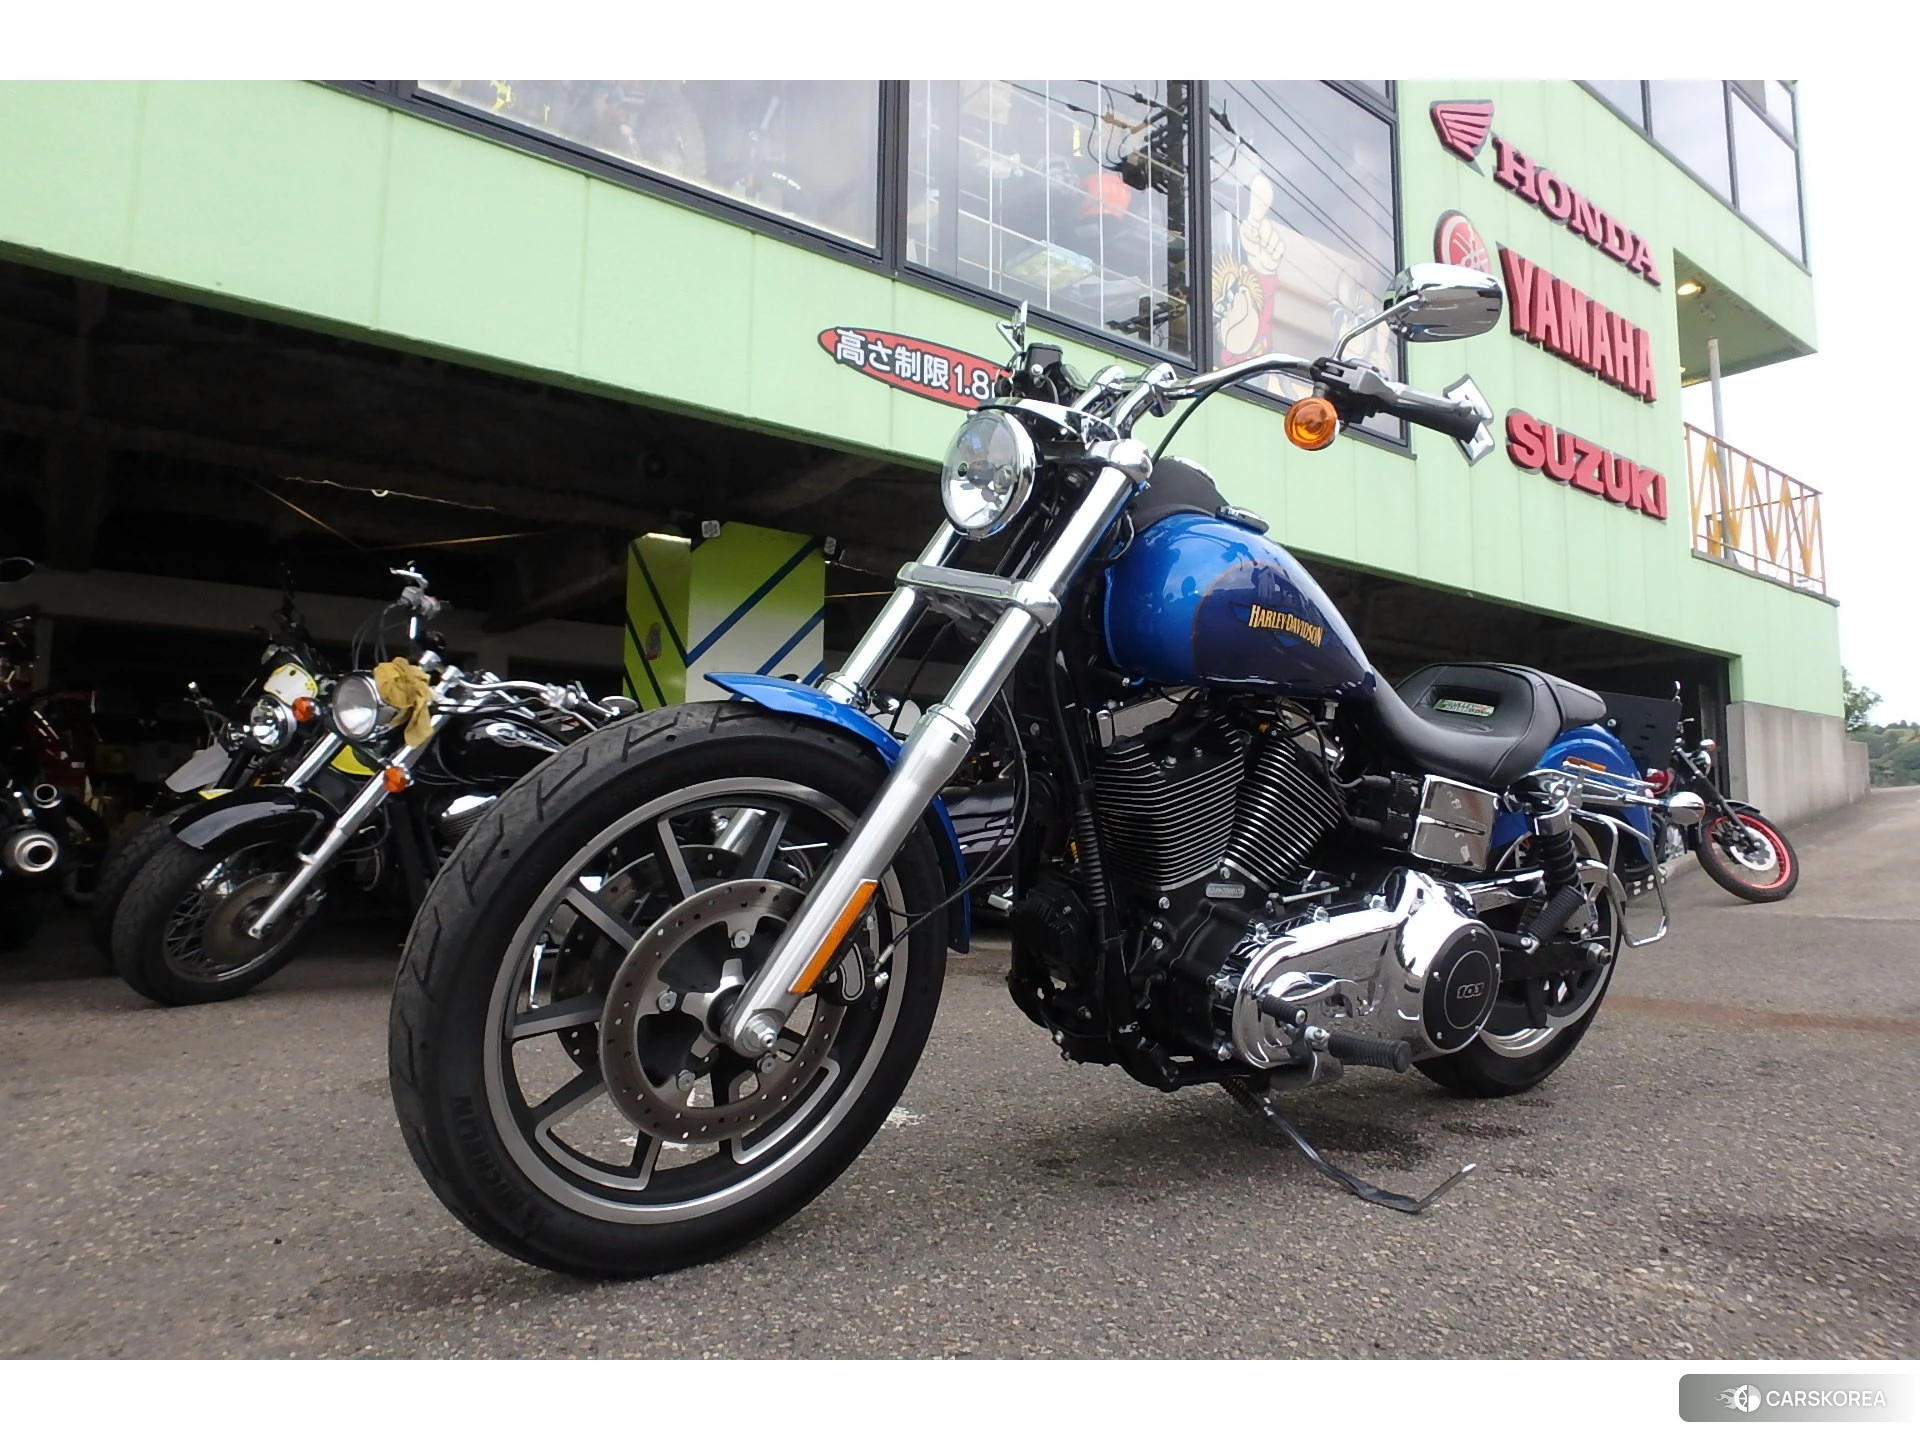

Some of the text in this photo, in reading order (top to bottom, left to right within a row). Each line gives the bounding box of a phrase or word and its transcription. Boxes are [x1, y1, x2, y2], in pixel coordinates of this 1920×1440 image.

[1491, 135, 1661, 287] HONDA
[836, 329, 998, 399] 高さ制限1.8
[1498, 246, 1657, 404] YAMAHA
[1505, 410, 1668, 520] SUZUKI
